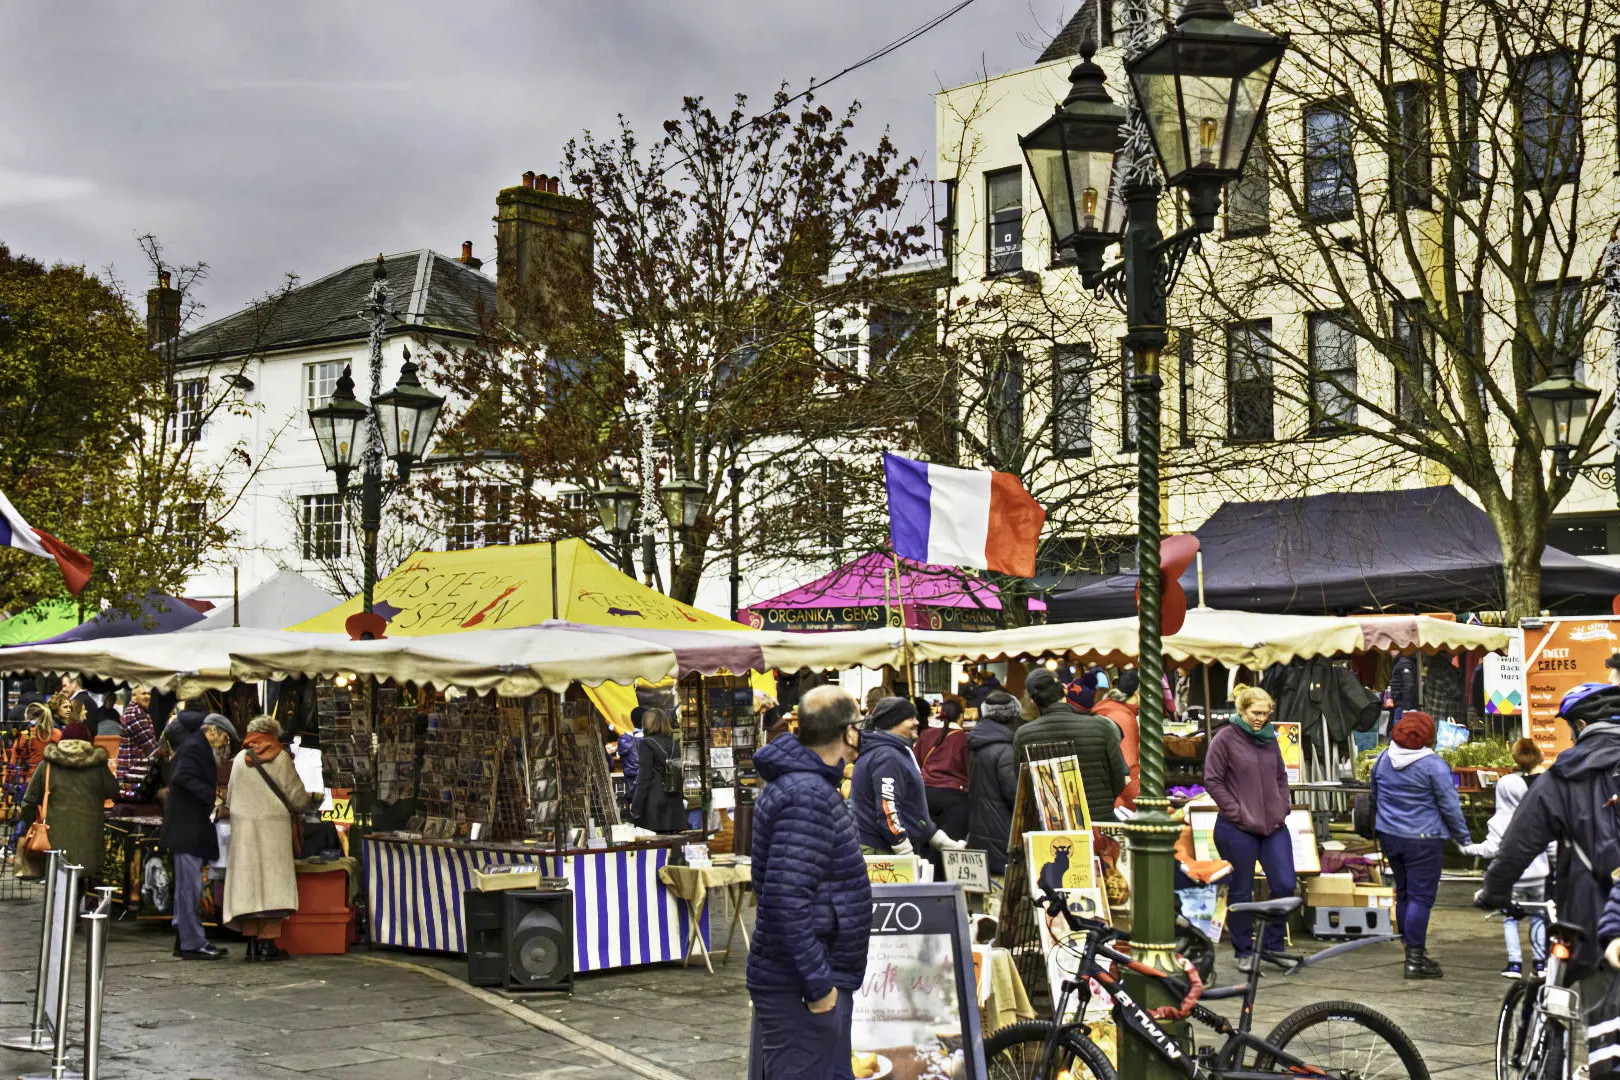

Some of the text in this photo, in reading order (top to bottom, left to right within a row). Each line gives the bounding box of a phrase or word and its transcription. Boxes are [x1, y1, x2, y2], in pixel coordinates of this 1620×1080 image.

[375, 571, 512, 600] TASTE OF
[768, 606, 880, 624] ORGANIKA GEMS
